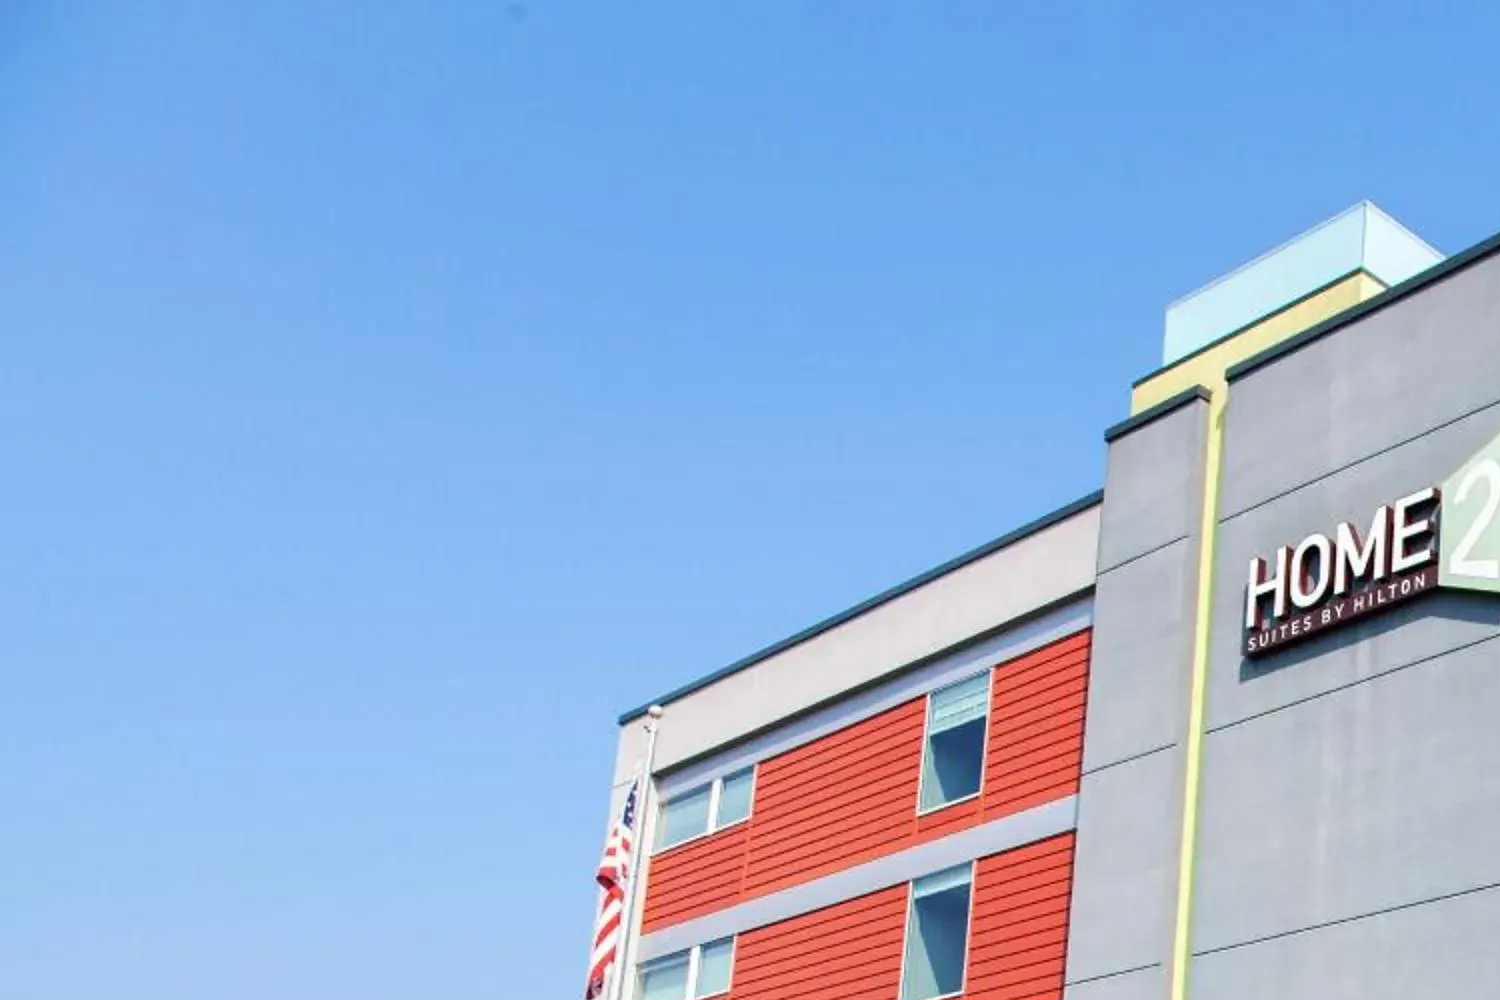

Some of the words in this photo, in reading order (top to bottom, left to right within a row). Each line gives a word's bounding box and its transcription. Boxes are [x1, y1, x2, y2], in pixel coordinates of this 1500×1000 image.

[1246, 487, 1438, 629] HOME
[1247, 616, 1312, 651] SUITES
[1321, 602, 1345, 624] BY
[1353, 572, 1426, 613] HILTON
